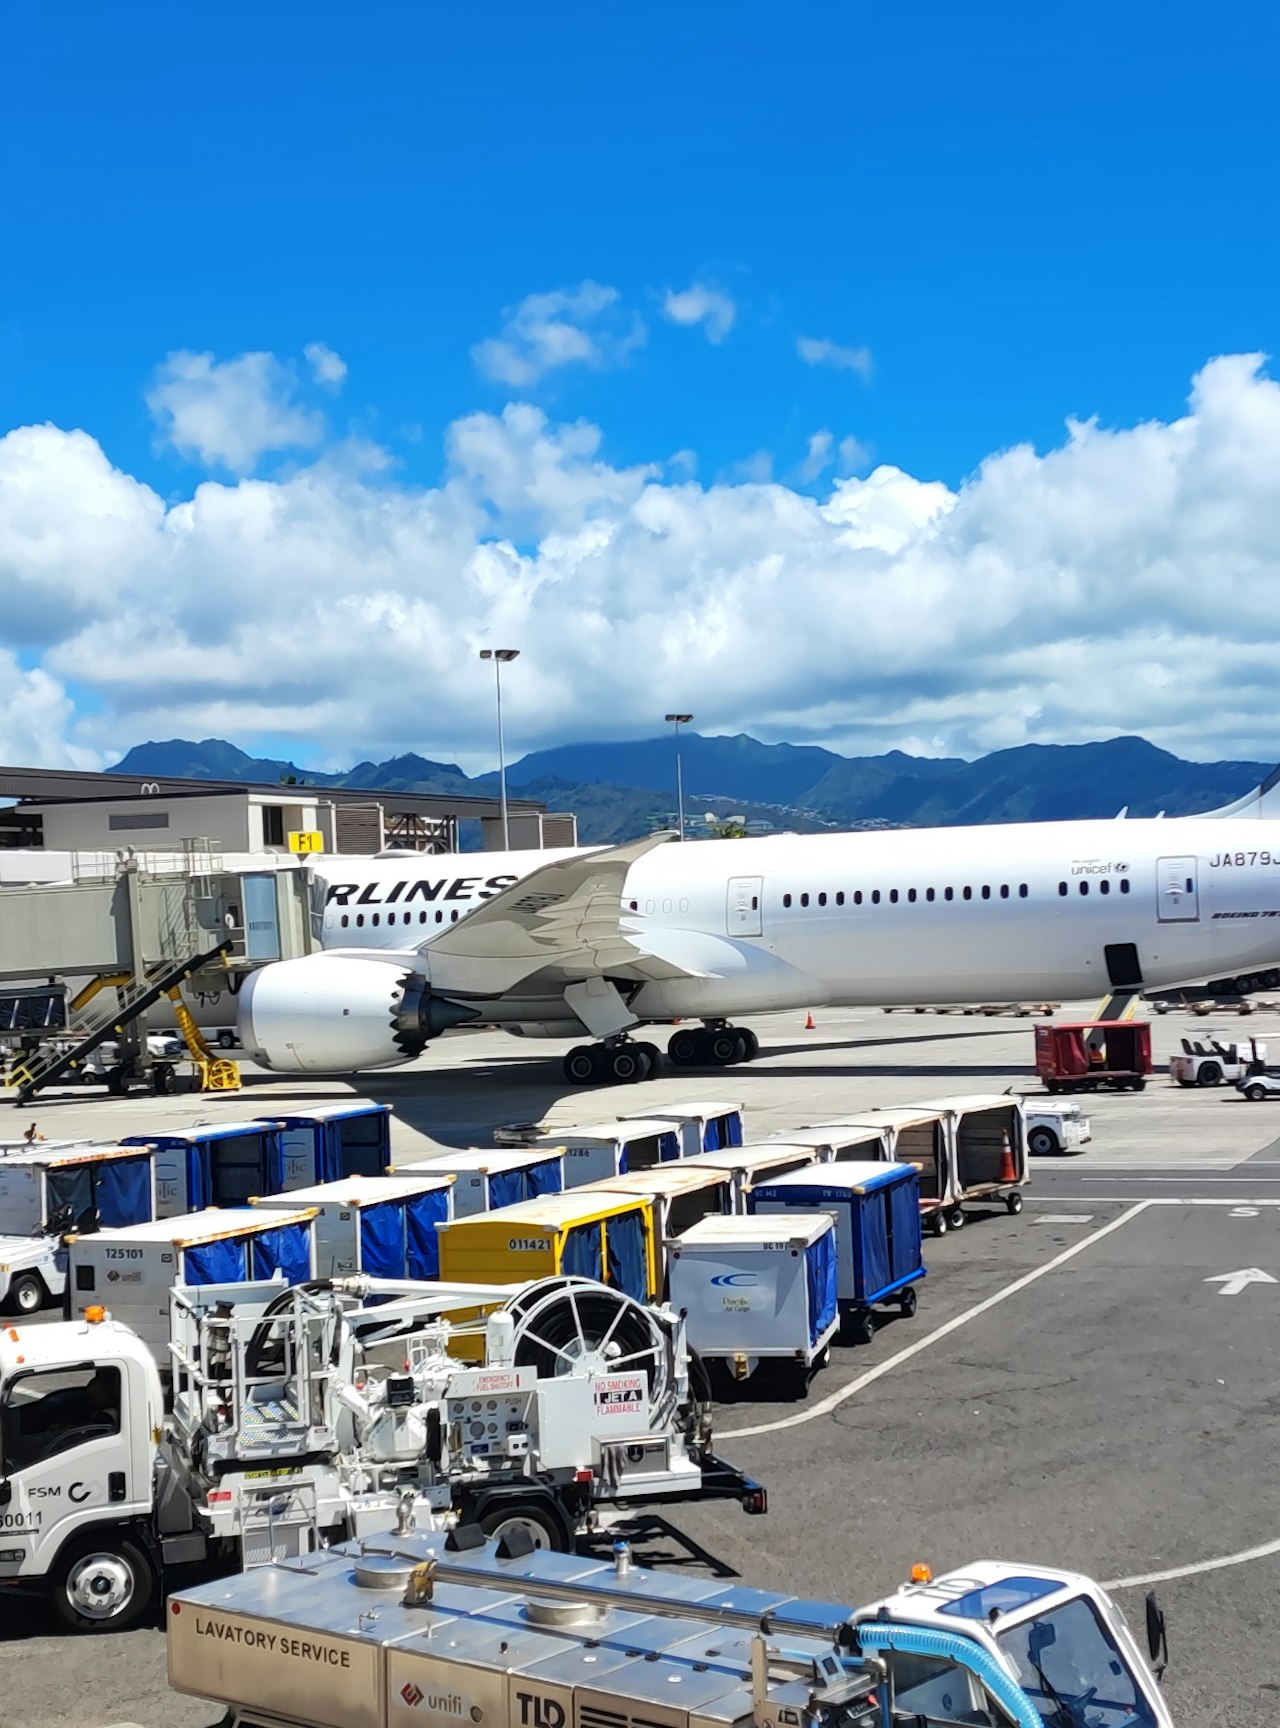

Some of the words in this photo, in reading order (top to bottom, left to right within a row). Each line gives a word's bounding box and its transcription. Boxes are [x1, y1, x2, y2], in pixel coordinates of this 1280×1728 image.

[298, 833, 313, 850] F1
[1071, 862, 1112, 876] unicef
[509, 1238, 551, 1251] 011421
[105, 1248, 144, 1260] 125101
[594, 1381, 606, 1392] NO
[607, 1378, 641, 1391] SMOKING
[604, 1391, 626, 1403] JET
[628, 1390, 637, 1402] A
[596, 1403, 641, 1416] FLAMMABLE
[28, 1486, 62, 1499] FSM
[195, 1618, 277, 1651] LAVATORY
[280, 1641, 351, 1669] SERVICE
[428, 1694, 463, 1717] unifi
[516, 1692, 566, 1728] TLD
